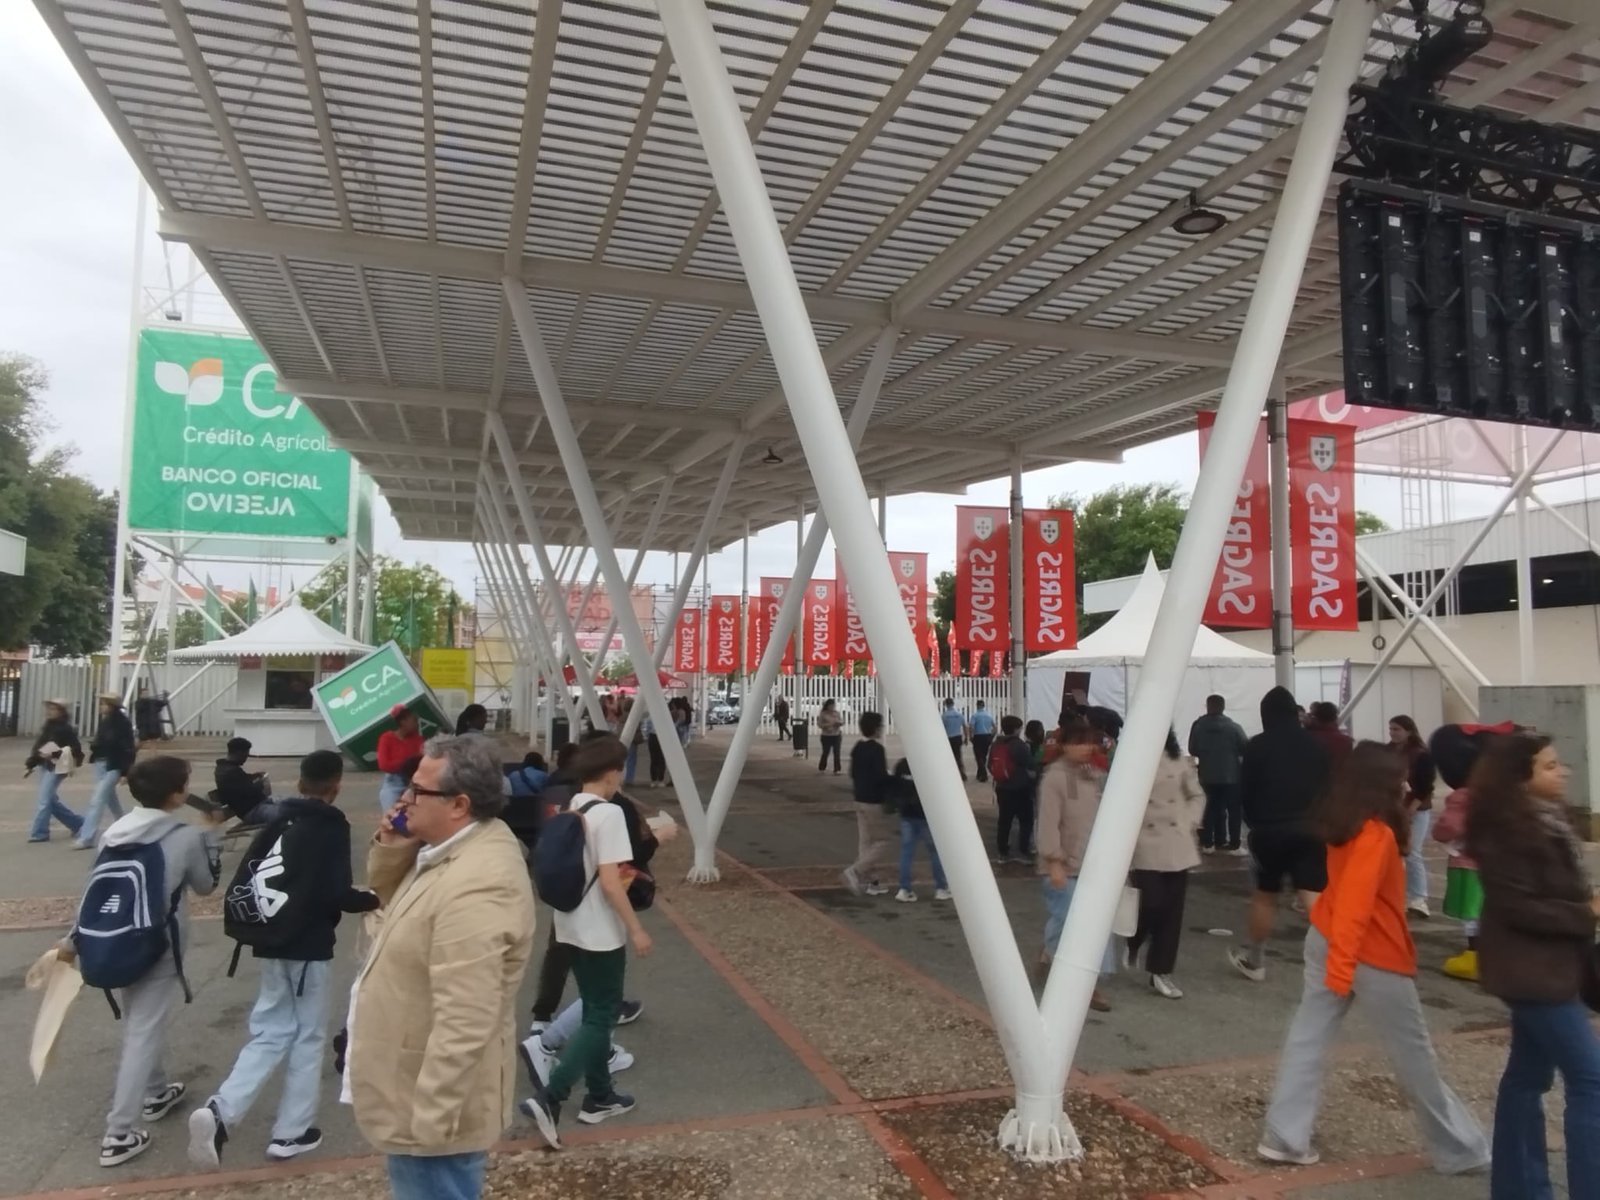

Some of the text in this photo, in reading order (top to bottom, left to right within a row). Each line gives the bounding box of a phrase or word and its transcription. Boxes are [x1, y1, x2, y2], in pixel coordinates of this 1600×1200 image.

[242, 363, 303, 419] C
[182, 426, 255, 446] Crédito
[161, 465, 322, 490] BANCO OFICIAL
[186, 492, 295, 516] OVIBEJA
[361, 665, 403, 694] CA
